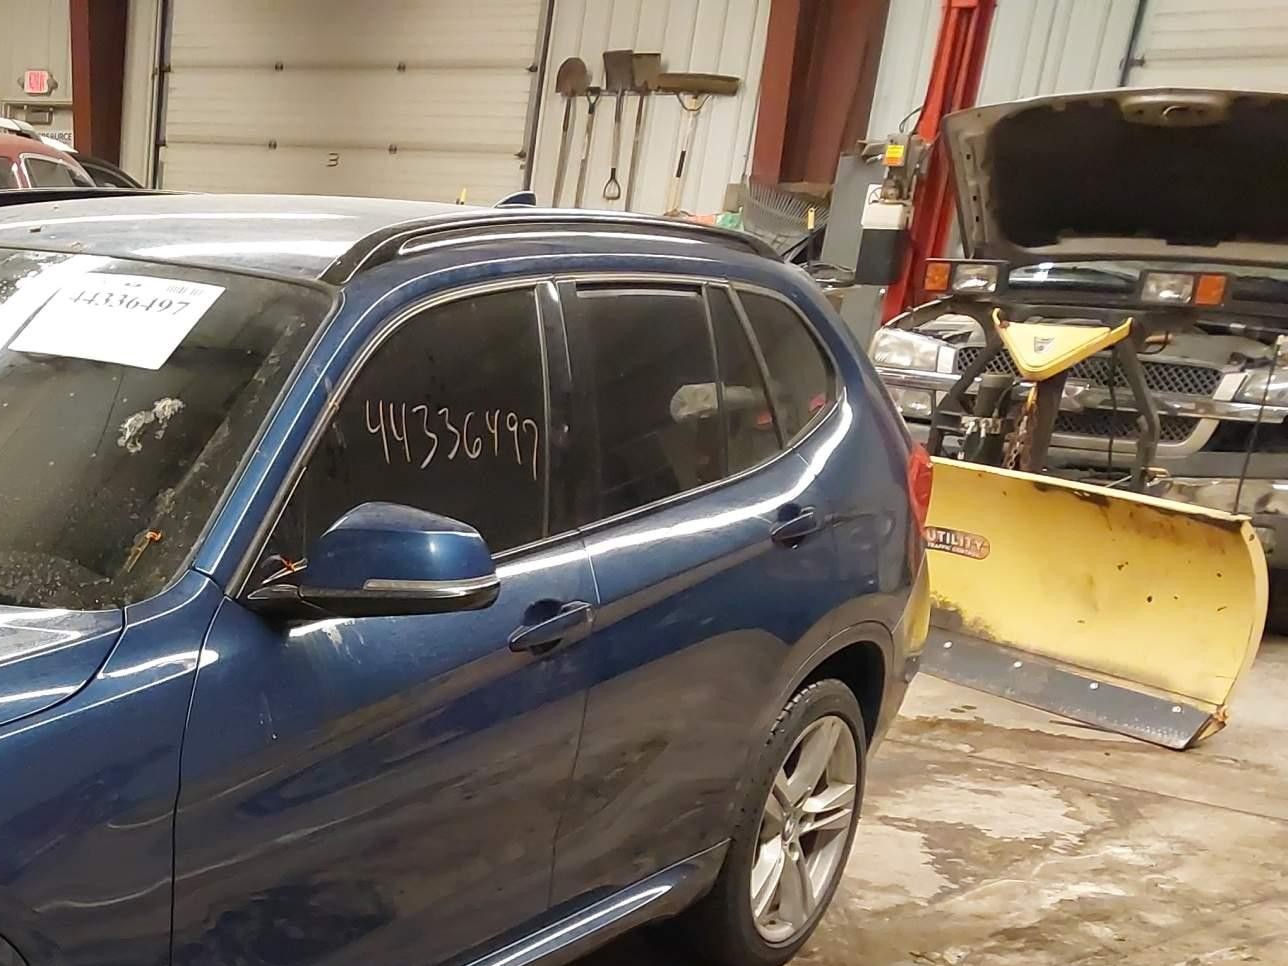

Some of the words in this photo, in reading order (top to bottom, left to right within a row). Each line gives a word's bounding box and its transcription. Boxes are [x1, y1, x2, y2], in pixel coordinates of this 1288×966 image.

[326, 152, 340, 168] 3
[365, 399, 539, 481] 44336497
[926, 528, 985, 551] UTILITY
